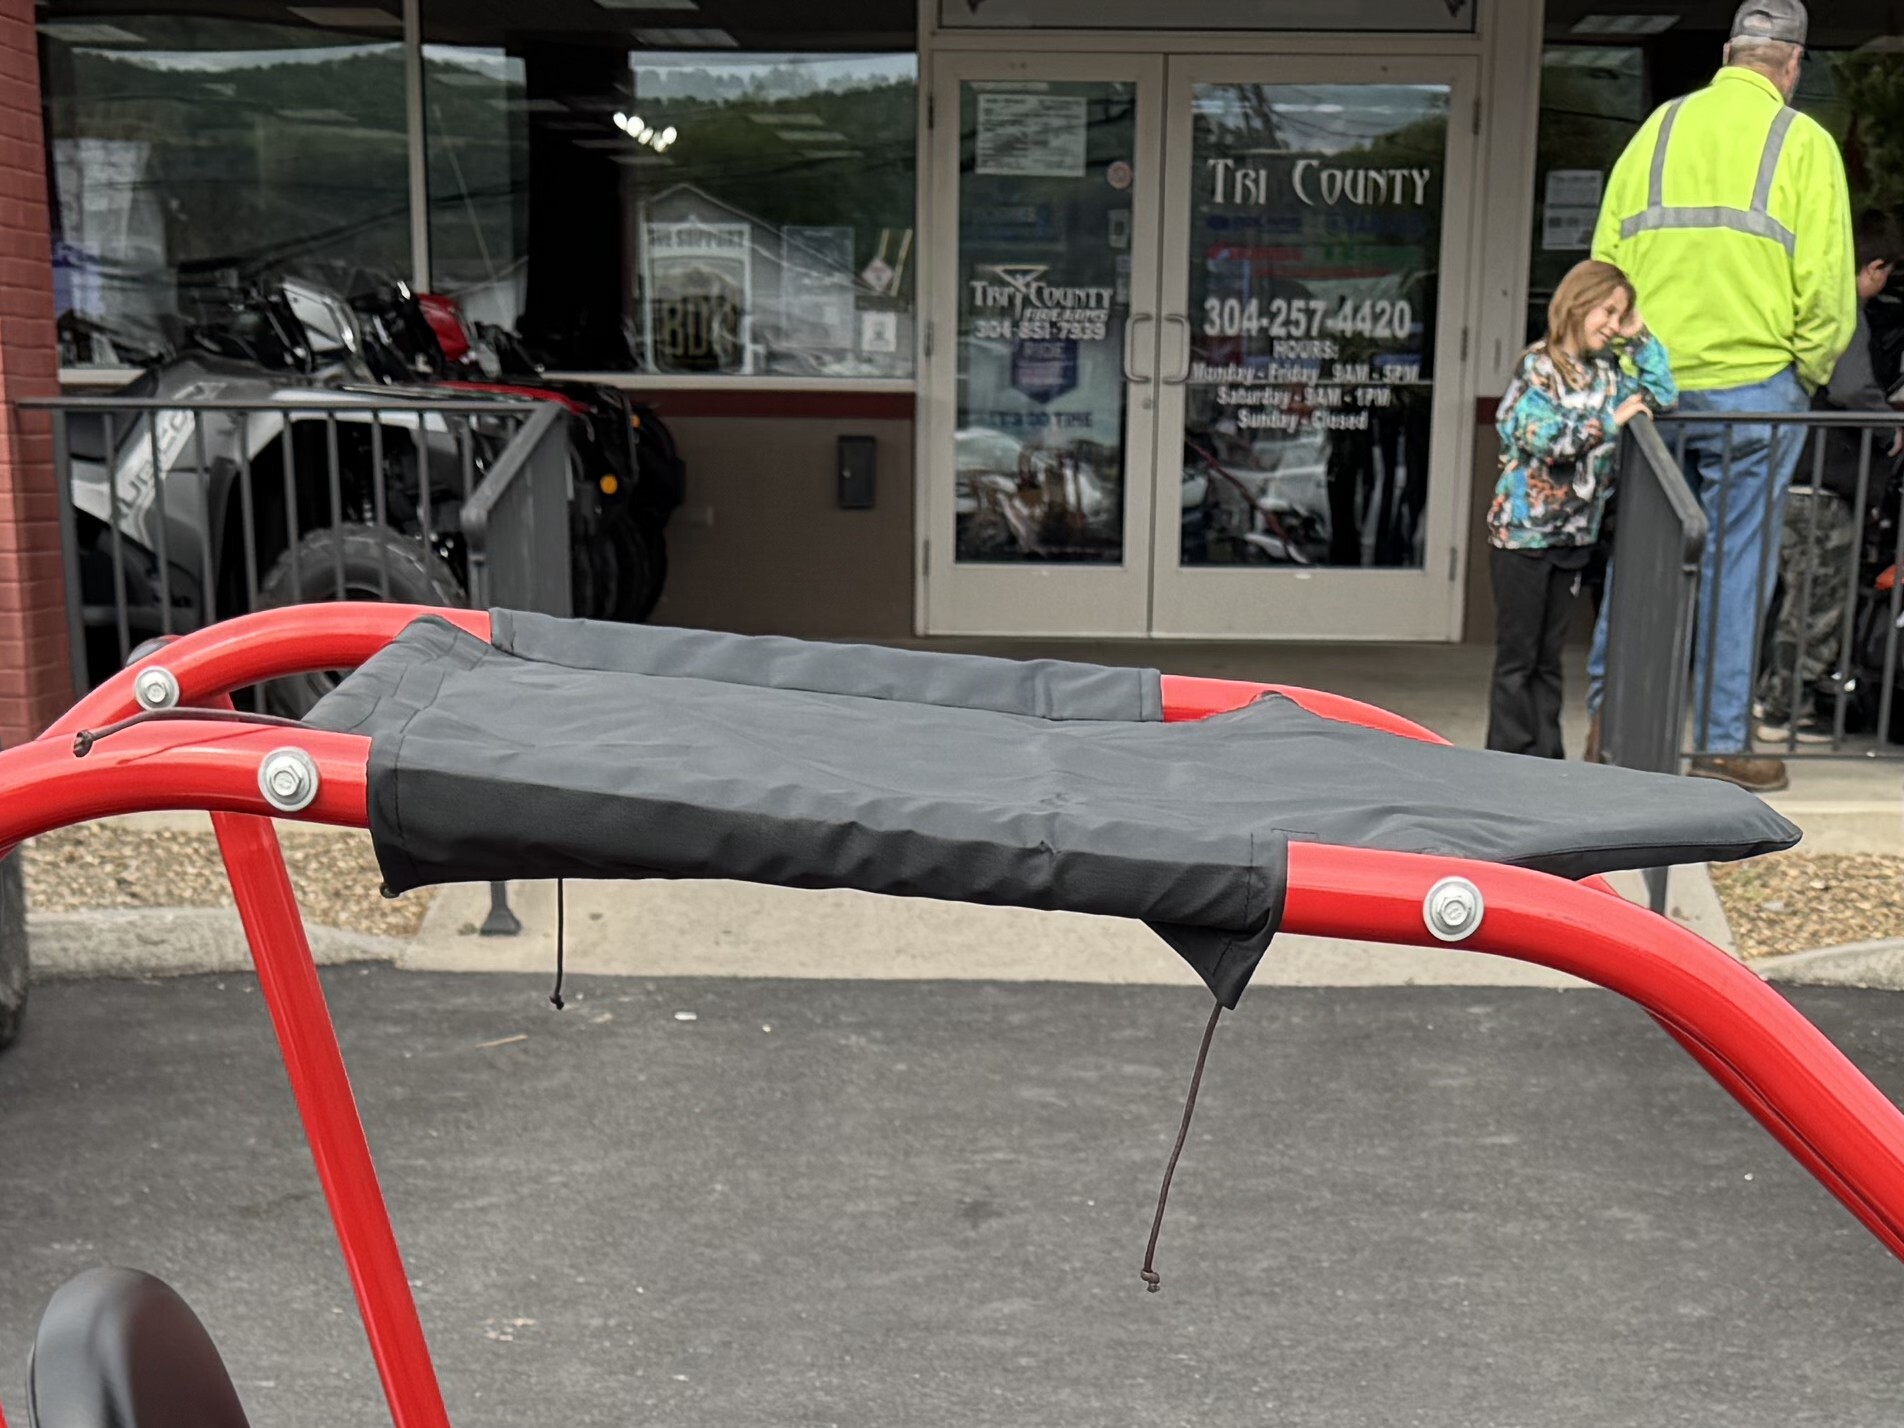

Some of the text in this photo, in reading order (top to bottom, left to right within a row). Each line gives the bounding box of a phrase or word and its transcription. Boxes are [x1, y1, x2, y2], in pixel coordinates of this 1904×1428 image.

[1203, 297, 1412, 339] 304-257-4420
[1273, 340, 1339, 359] HOURS:
[1191, 362, 1256, 385] Monday
[1268, 363, 1321, 386] Friday
[1331, 363, 1370, 382] 9AM
[1216, 385, 1291, 410] Saturday
[1303, 387, 1343, 407] 9AM
[1354, 387, 1392, 408] 1PM
[1237, 409, 1299, 434] Sunday
[1310, 409, 1369, 430] Closed
